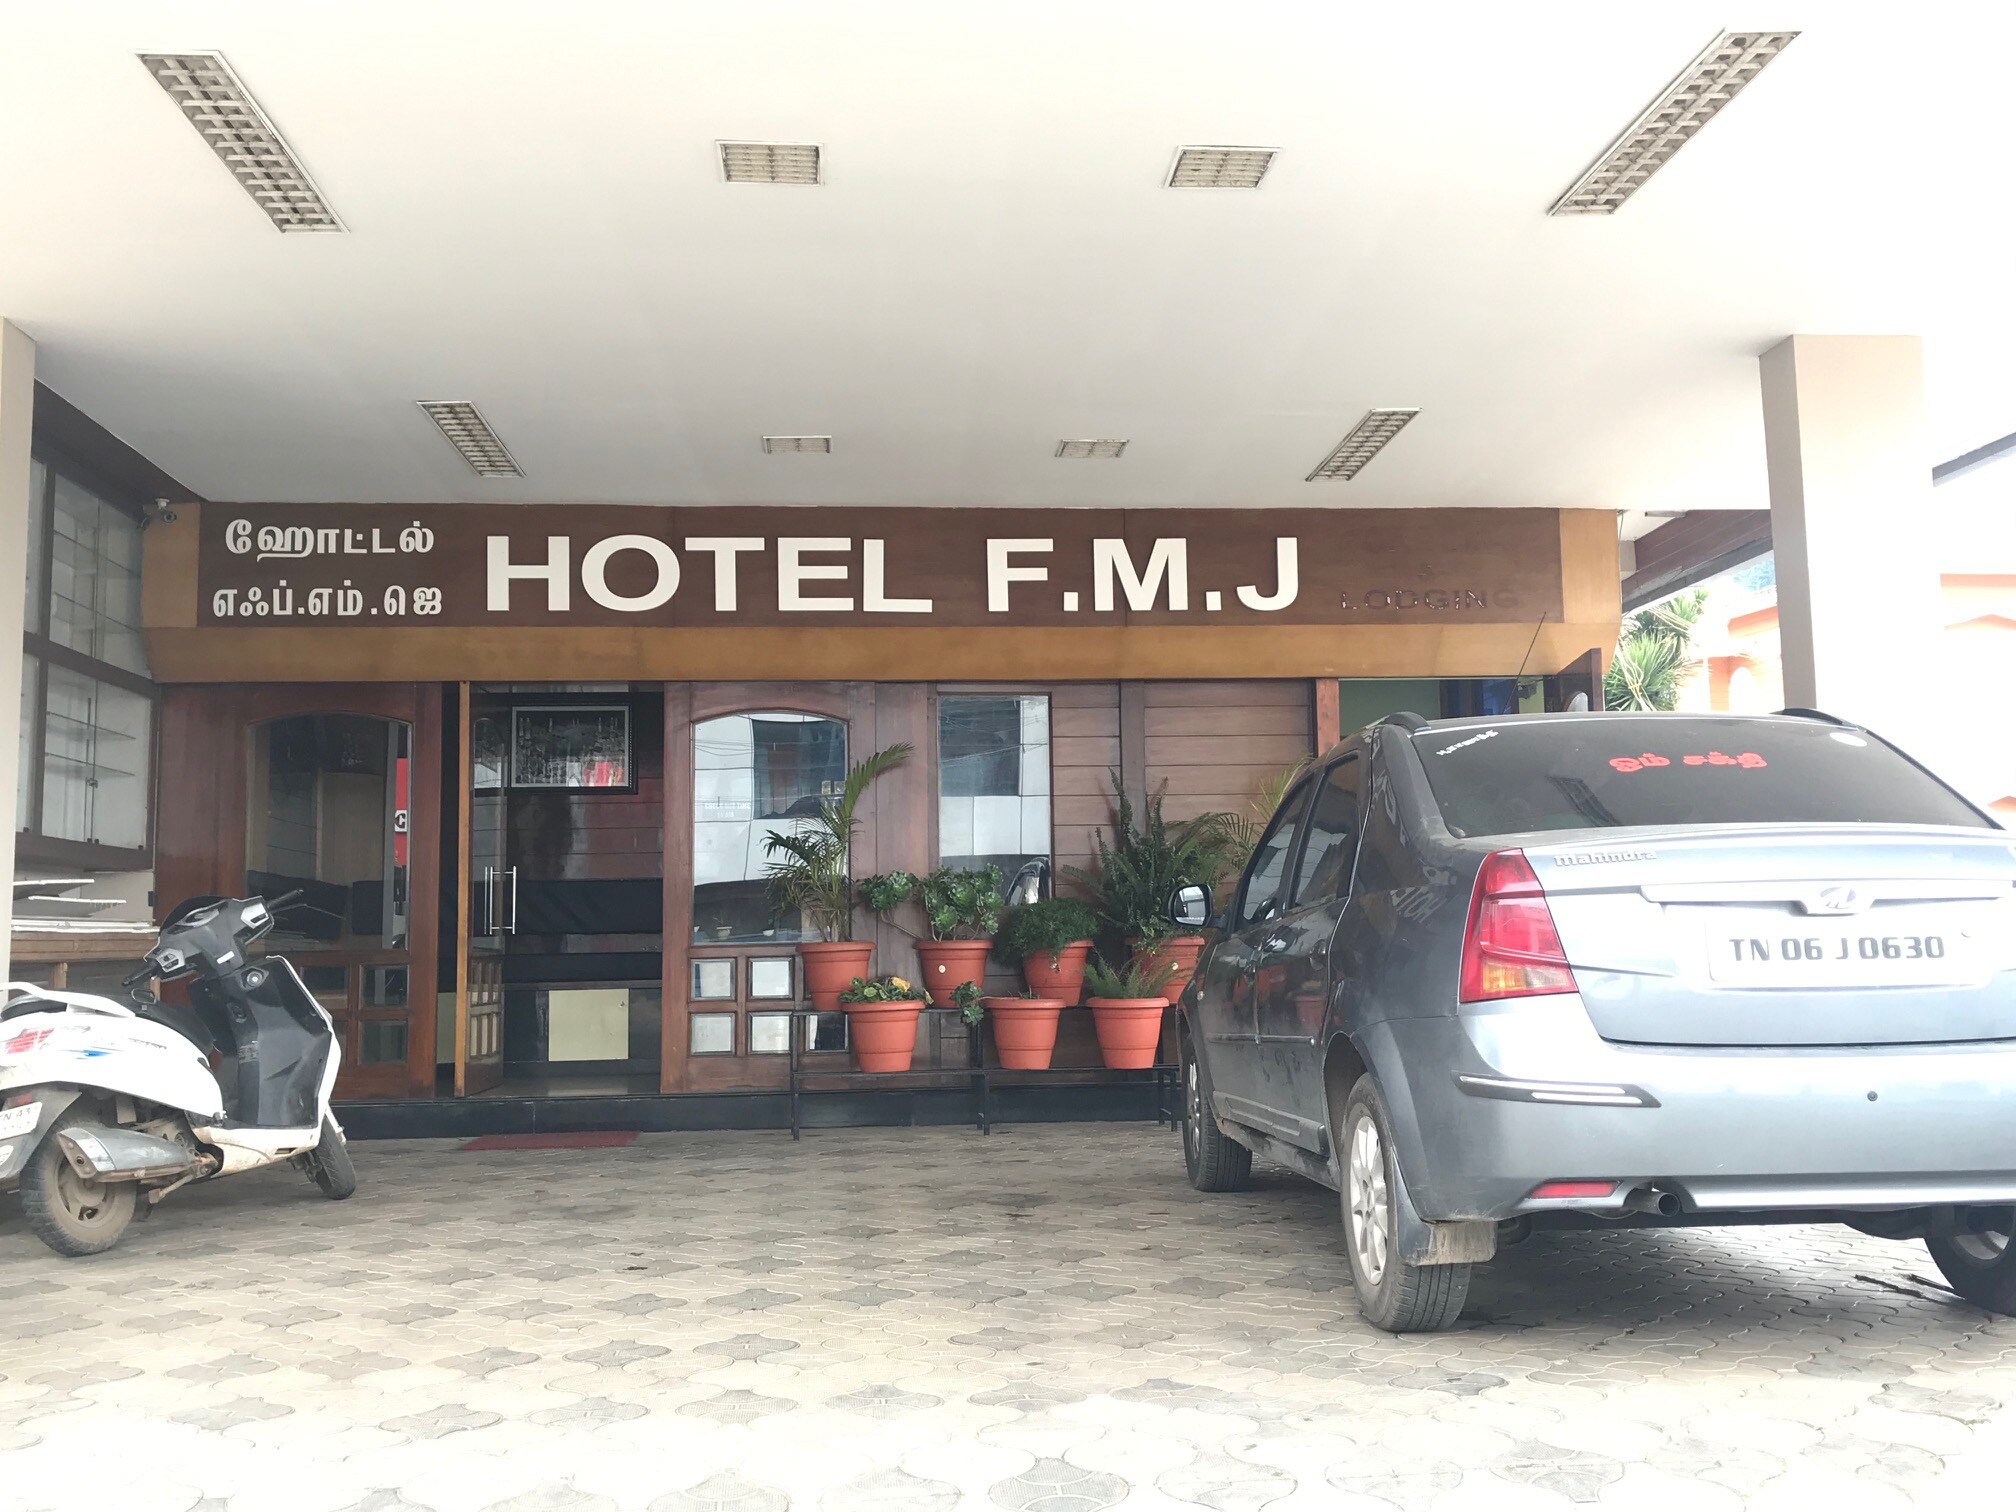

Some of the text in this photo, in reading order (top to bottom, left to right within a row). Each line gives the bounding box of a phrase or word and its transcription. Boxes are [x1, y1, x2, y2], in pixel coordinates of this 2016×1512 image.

[225, 518, 435, 563] ஹோட்டல்
[486, 534, 1299, 613] HOTEL F.M.J
[212, 579, 443, 618] எஃப்.எம்.ஜெ
[1339, 588, 1521, 611] LODGING
[1729, 936, 1945, 961] TN 06 J 0630
